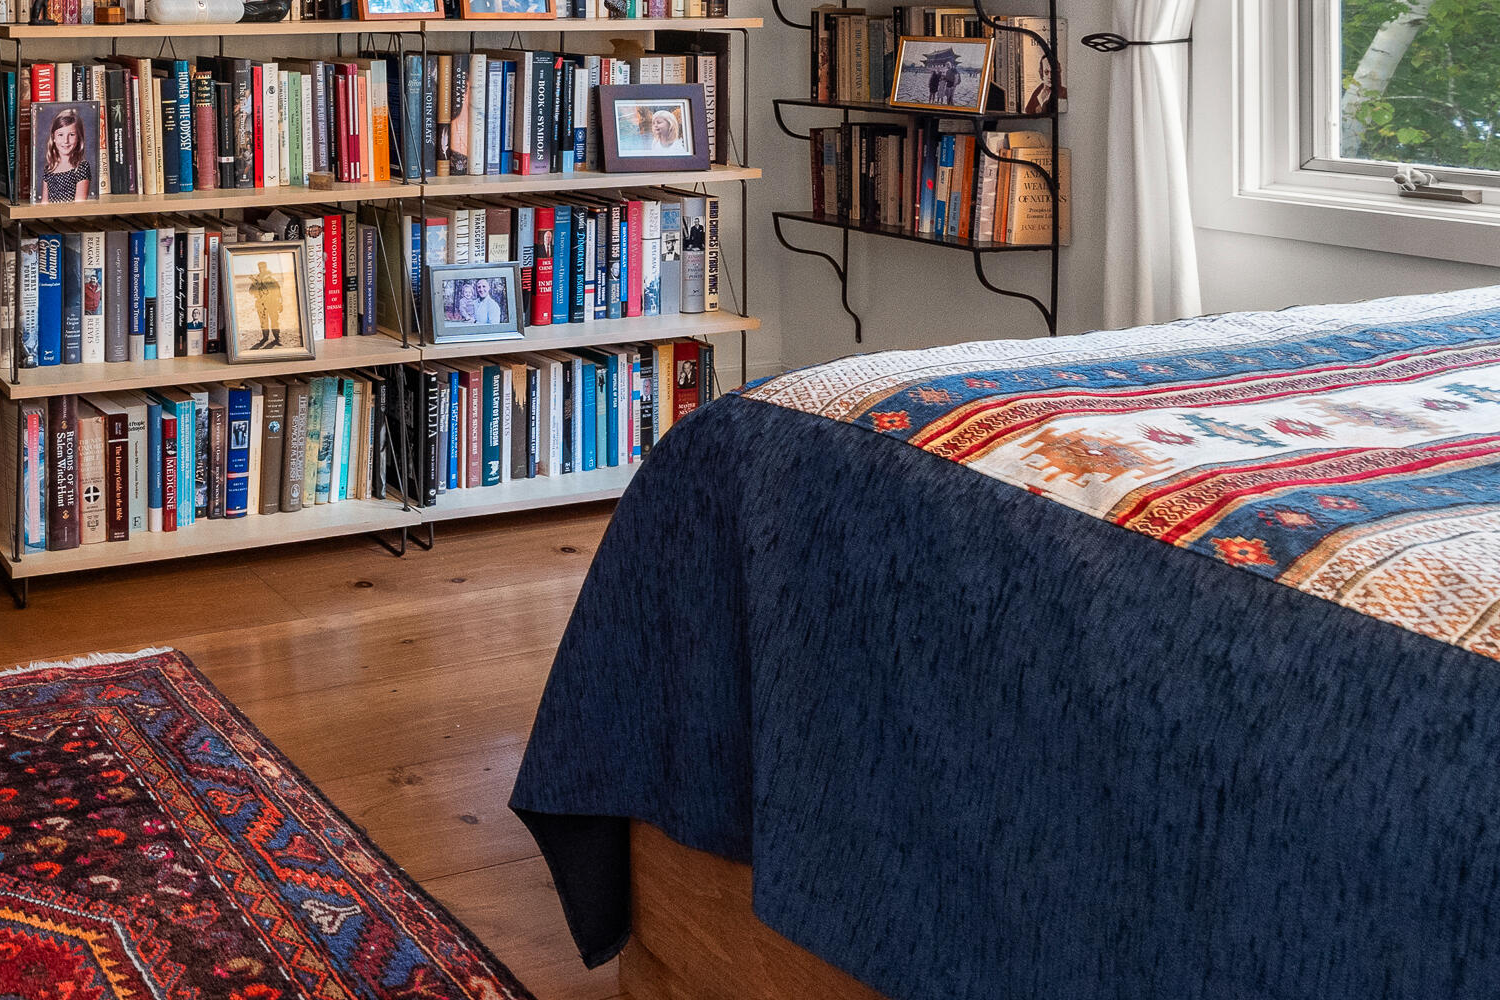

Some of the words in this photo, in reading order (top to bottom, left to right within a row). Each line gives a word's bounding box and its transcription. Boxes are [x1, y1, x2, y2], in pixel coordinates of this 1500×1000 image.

[179, 71, 188, 98] HOMER
[179, 103, 189, 118] THE
[180, 119, 190, 150] ODYSSEY
[536, 117, 544, 160] SYMBOLS
[708, 201, 718, 217] HARD
[612, 207, 620, 242] EISENHOWER
[708, 219, 718, 248] CHOICES
[39, 239, 50, 274] Ground
[49, 239, 60, 279] Common
[348, 220, 356, 273] KISSINGER
[576, 232, 585, 272] DEMOCRACY'S
[612, 244, 620, 257] 1956
[708, 252, 718, 271] CYRUS
[708, 272, 718, 295] VANCE
[429, 388, 438, 437] ITALIA
[57, 433, 65, 458] Salem
[57, 459, 65, 507] Witch-Hunt
[67, 474, 74, 485] OF
